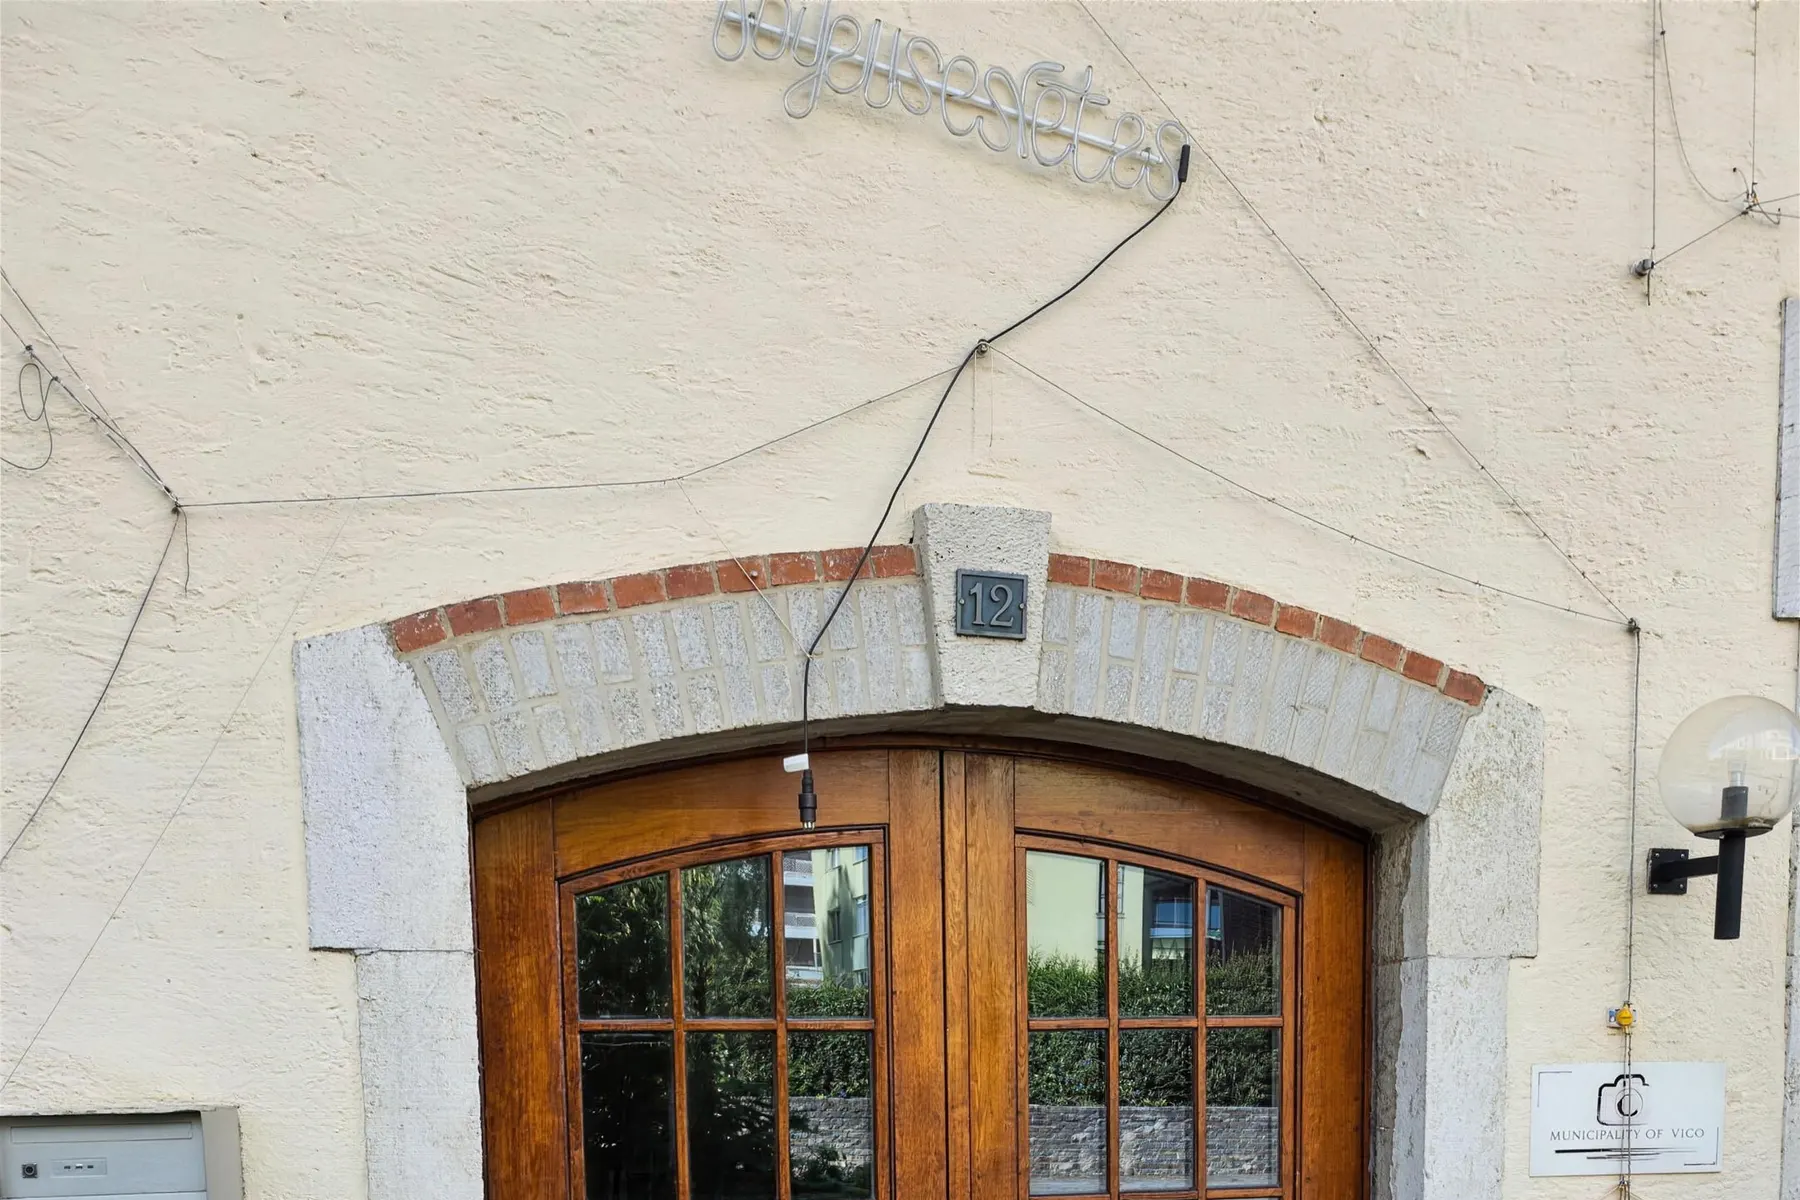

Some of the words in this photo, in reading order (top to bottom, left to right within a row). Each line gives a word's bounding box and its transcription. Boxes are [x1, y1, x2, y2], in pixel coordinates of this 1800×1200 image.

[969, 582, 1014, 627] 12
[1550, 1129, 1641, 1141] MUNICIPALITY
[1645, 1129, 1664, 1140] OF
[1671, 1128, 1705, 1139] VICO
